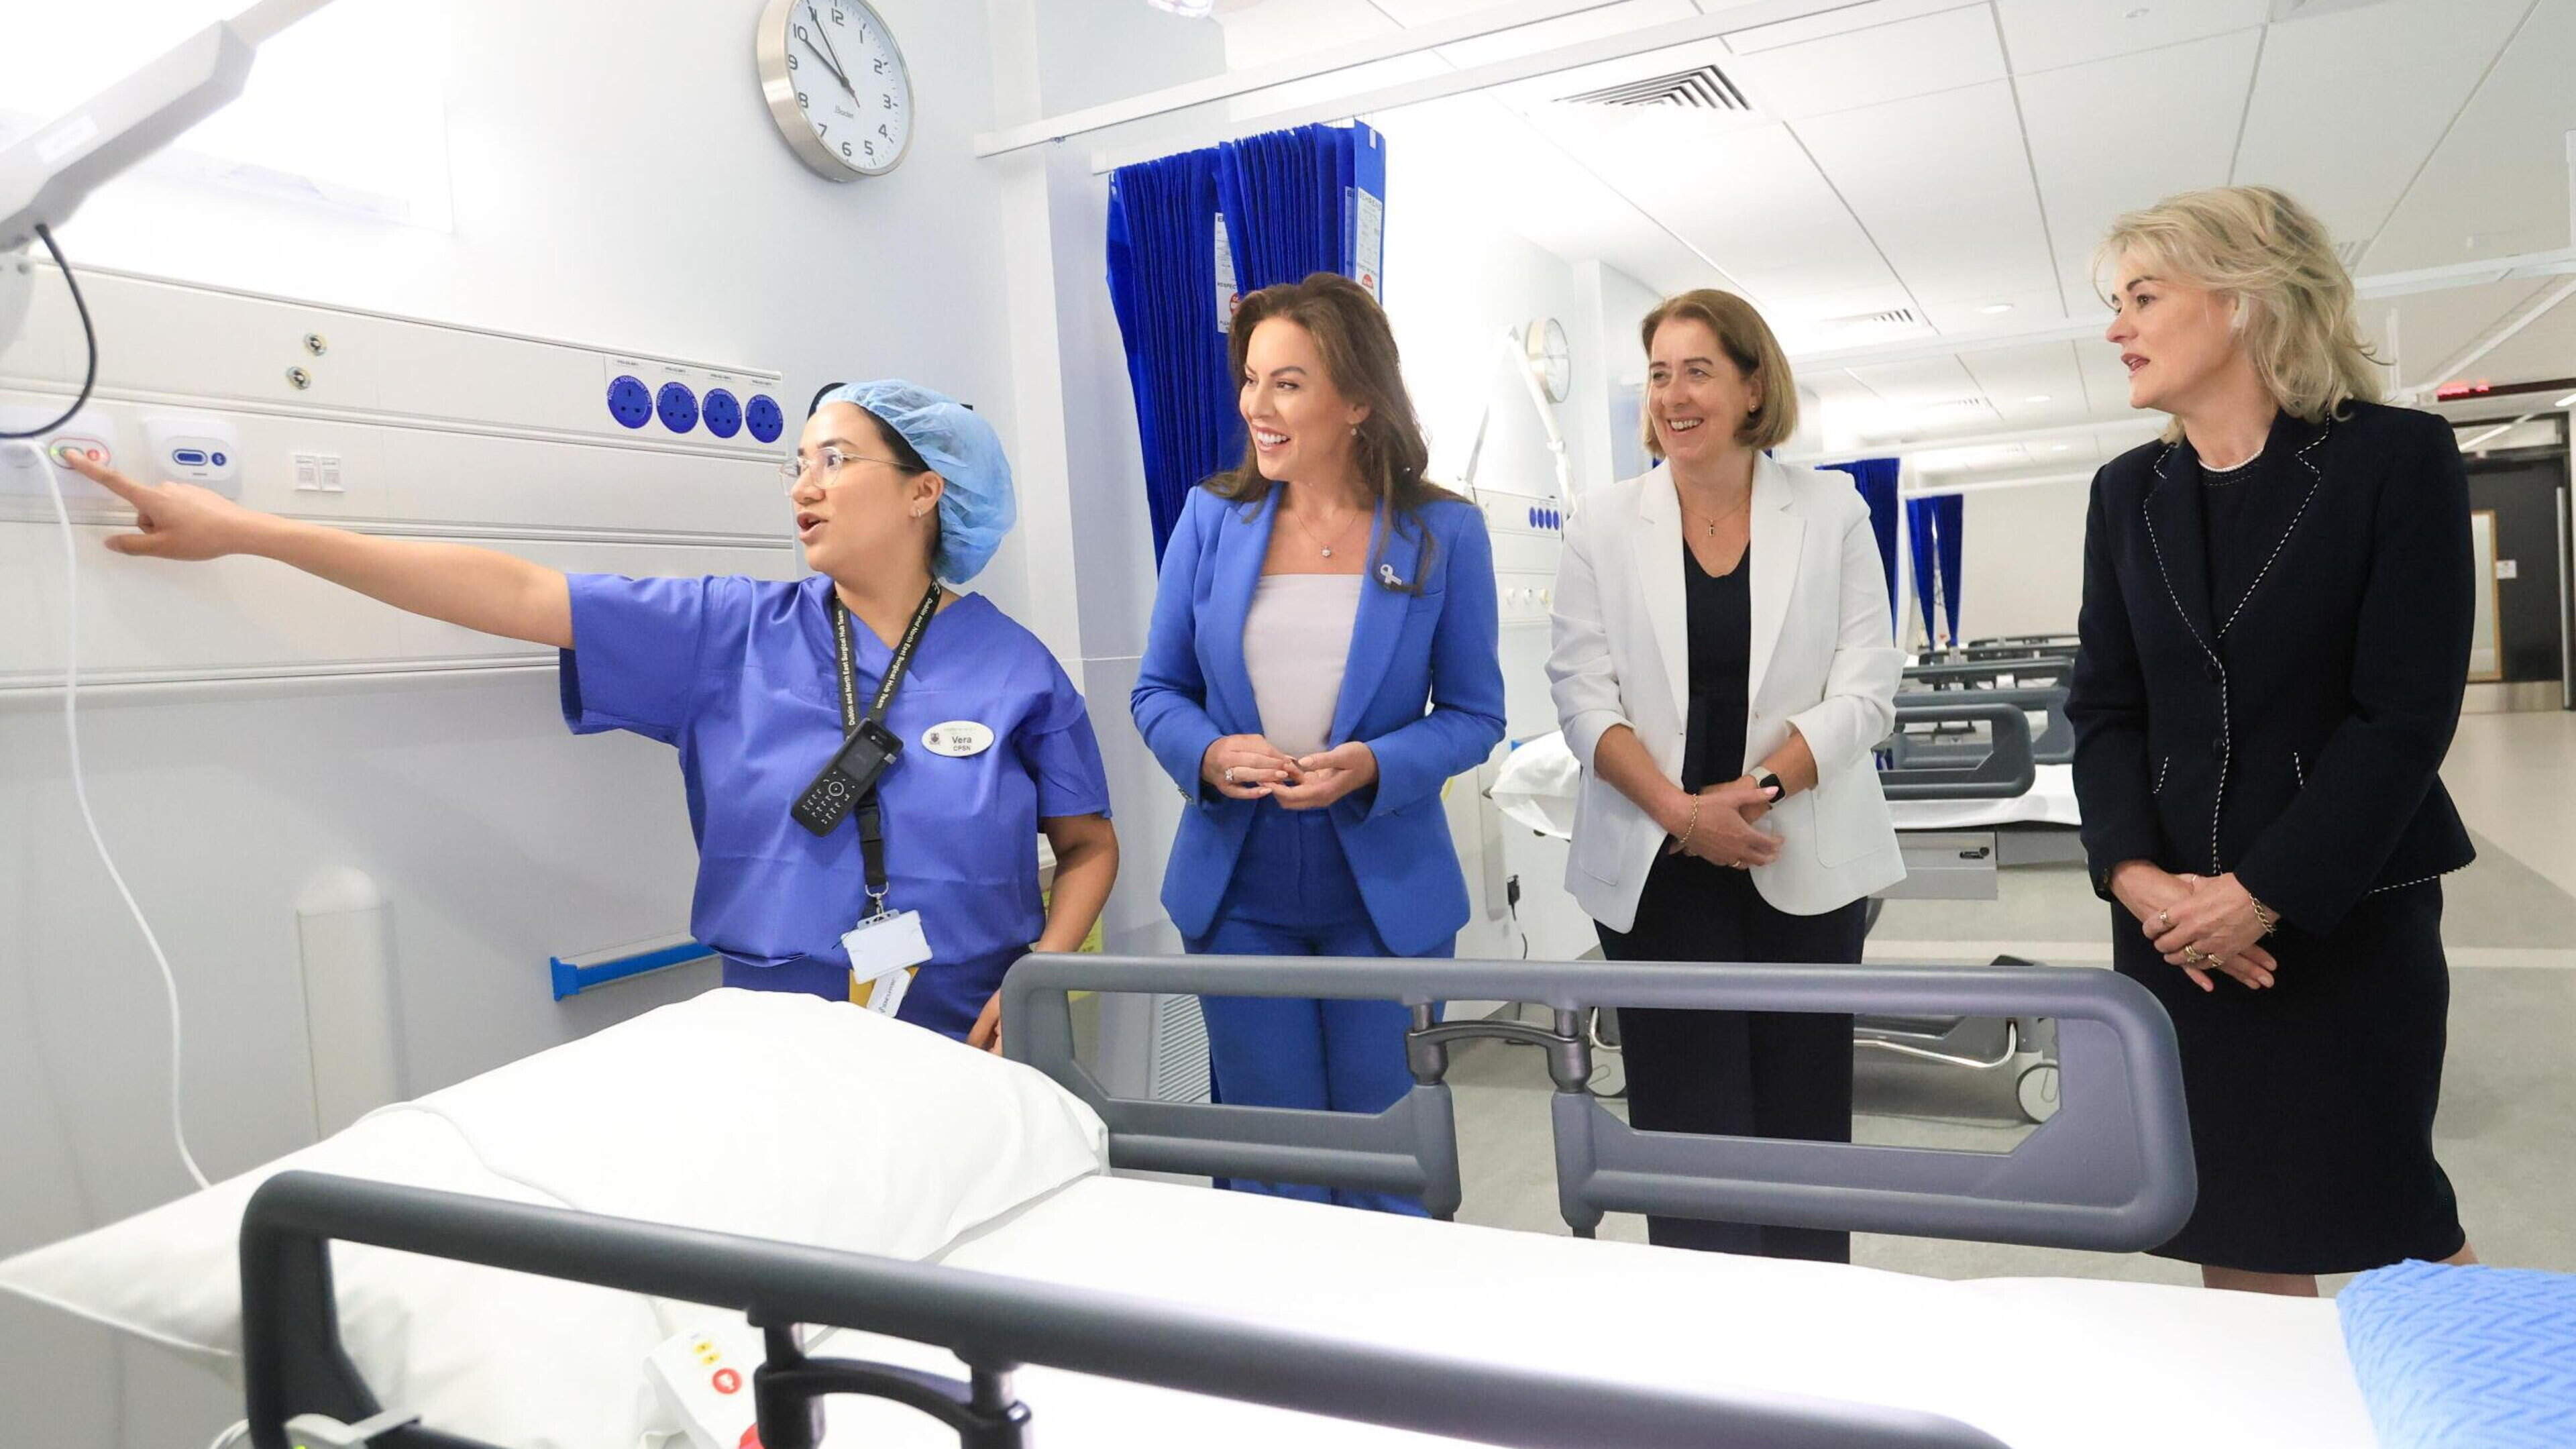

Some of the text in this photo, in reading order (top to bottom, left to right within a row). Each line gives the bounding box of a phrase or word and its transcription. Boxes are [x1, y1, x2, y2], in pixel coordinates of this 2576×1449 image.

[831, 7, 845, 27] 12
[794, 23, 808, 42] 10
[859, 30, 863, 44] 1
[788, 54, 798, 70] 9
[873, 58, 883, 74] 2
[798, 92, 808, 109] 8
[883, 94, 892, 109] 3
[818, 123, 828, 137] 7
[877, 123, 888, 139] 4
[842, 142, 852, 158] 6
[864, 140, 873, 156] 5
[952, 736, 972, 744] Vera
